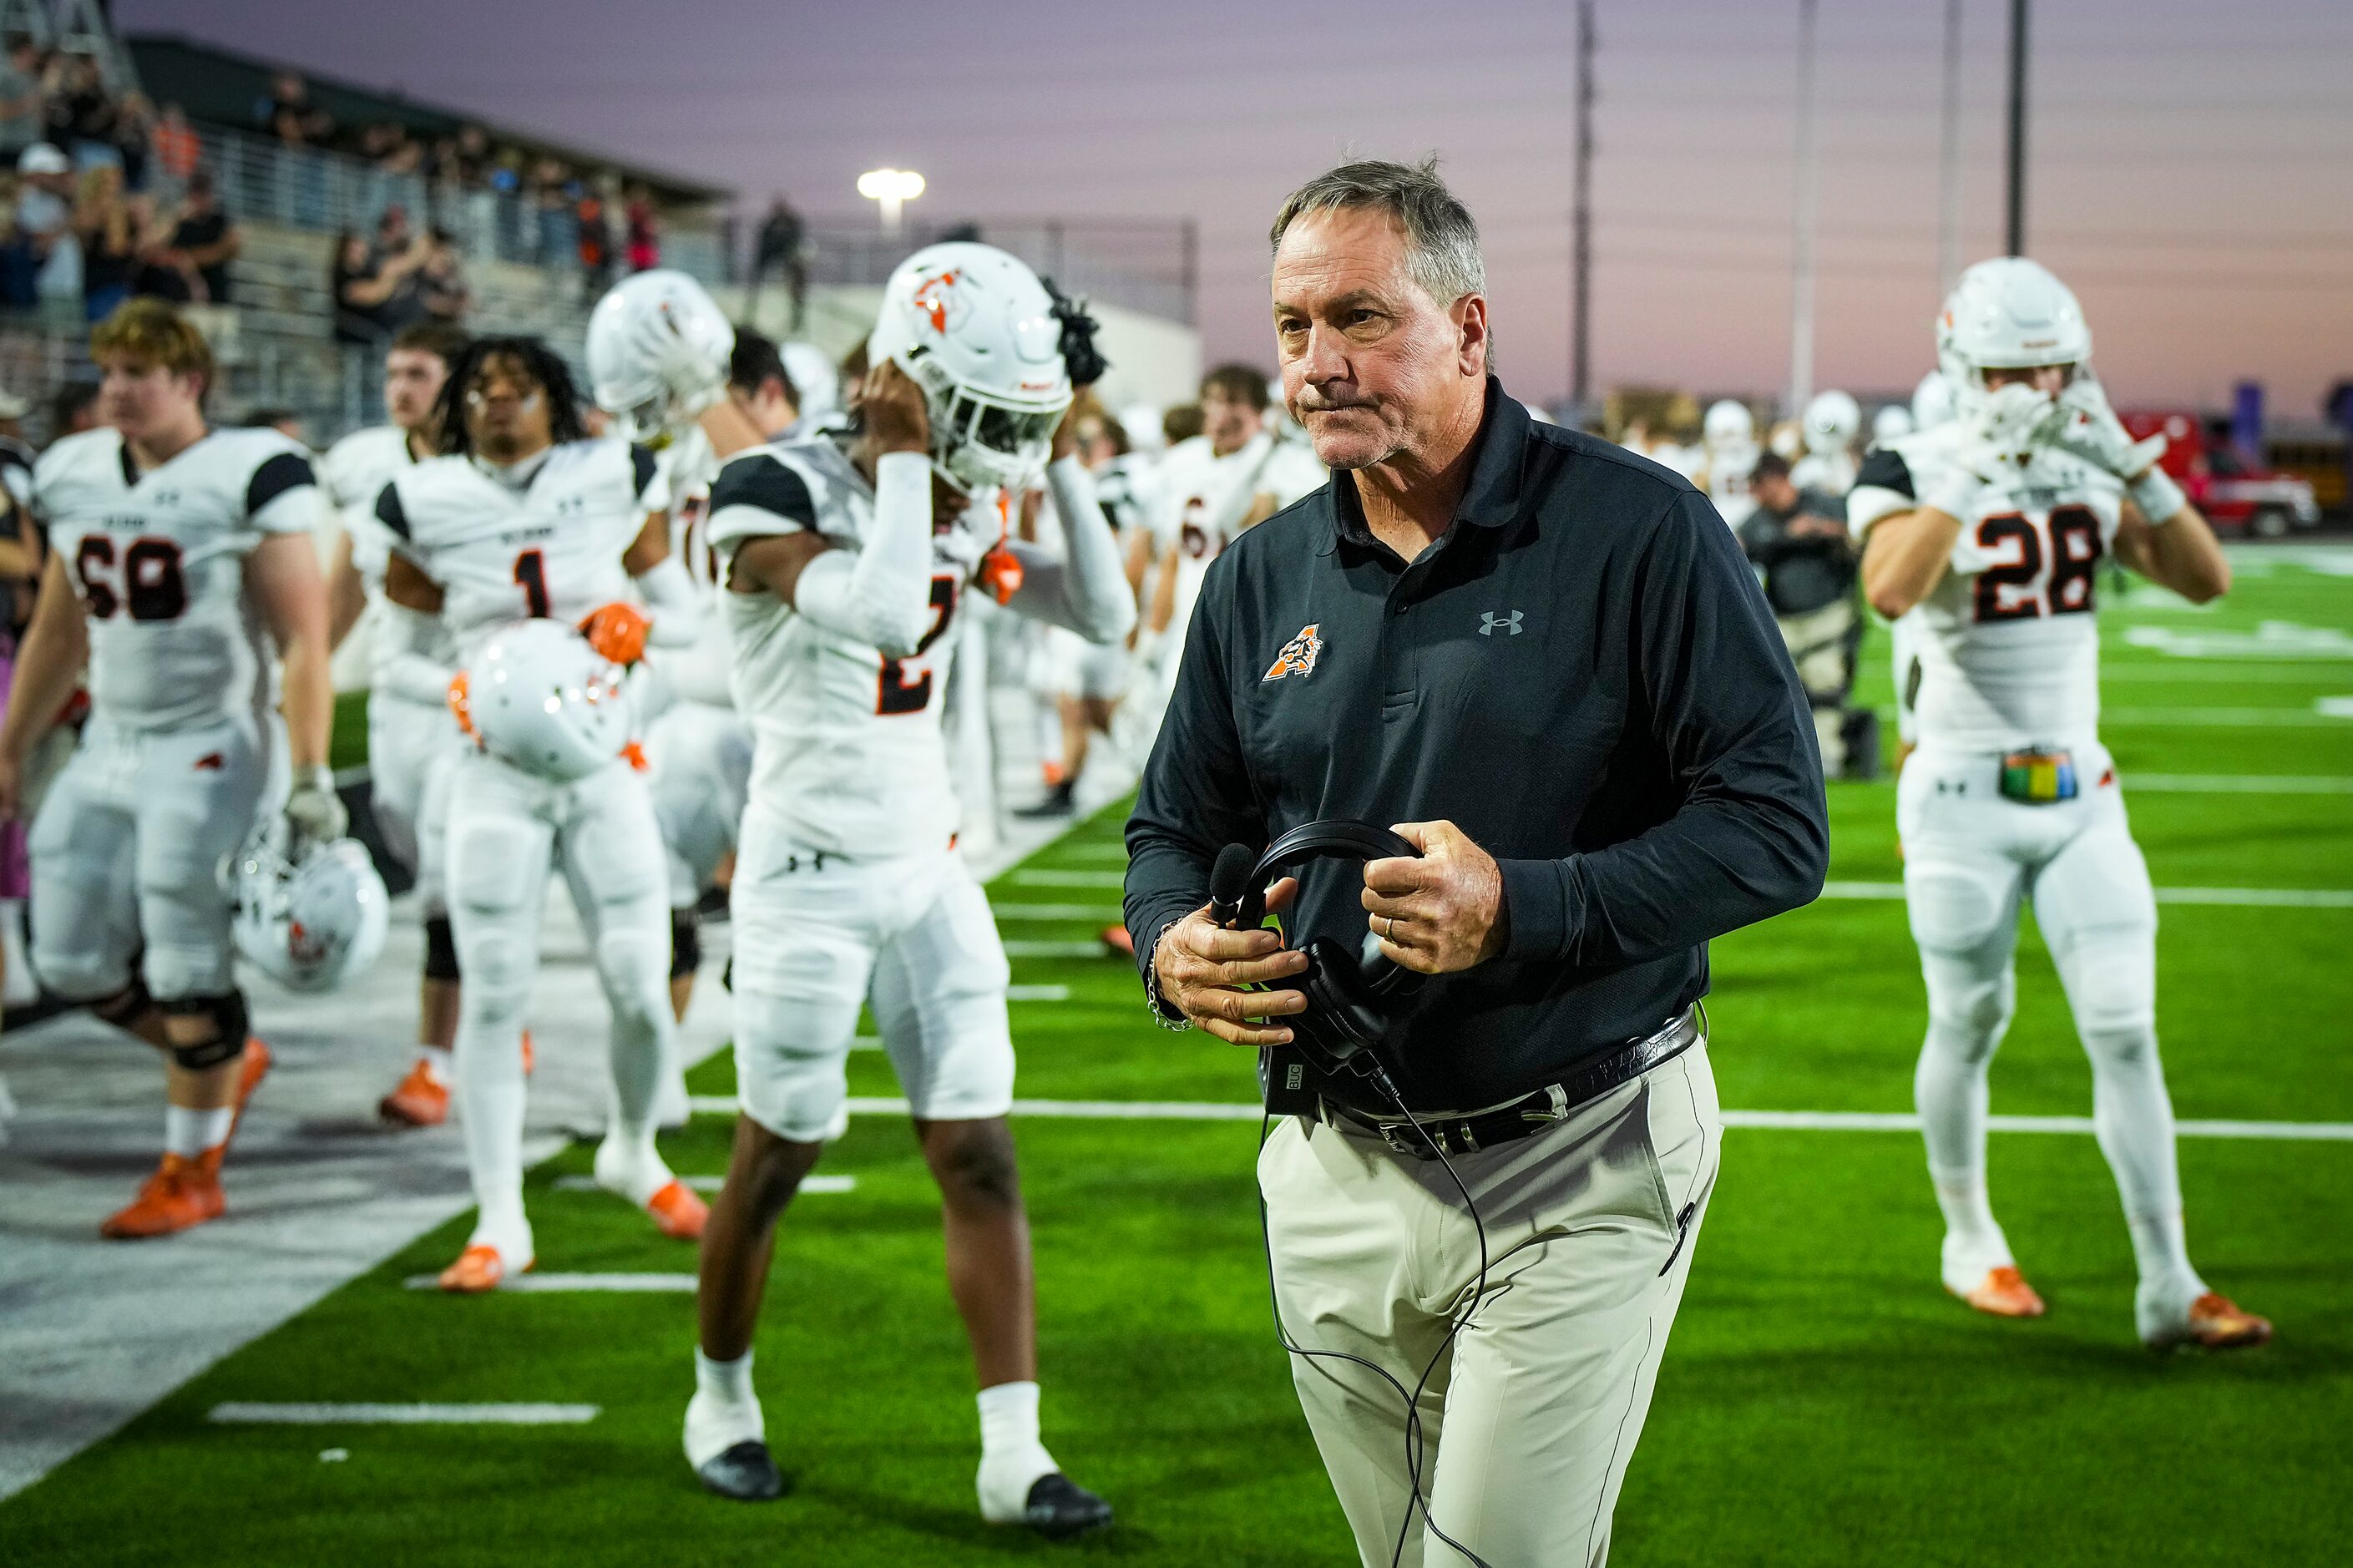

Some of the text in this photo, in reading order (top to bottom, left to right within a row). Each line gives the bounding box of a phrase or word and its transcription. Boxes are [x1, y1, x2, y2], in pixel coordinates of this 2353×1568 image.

[513, 548, 552, 619] 1
[1974, 504, 2103, 622] 28
[1288, 1065, 1301, 1089] BUC
